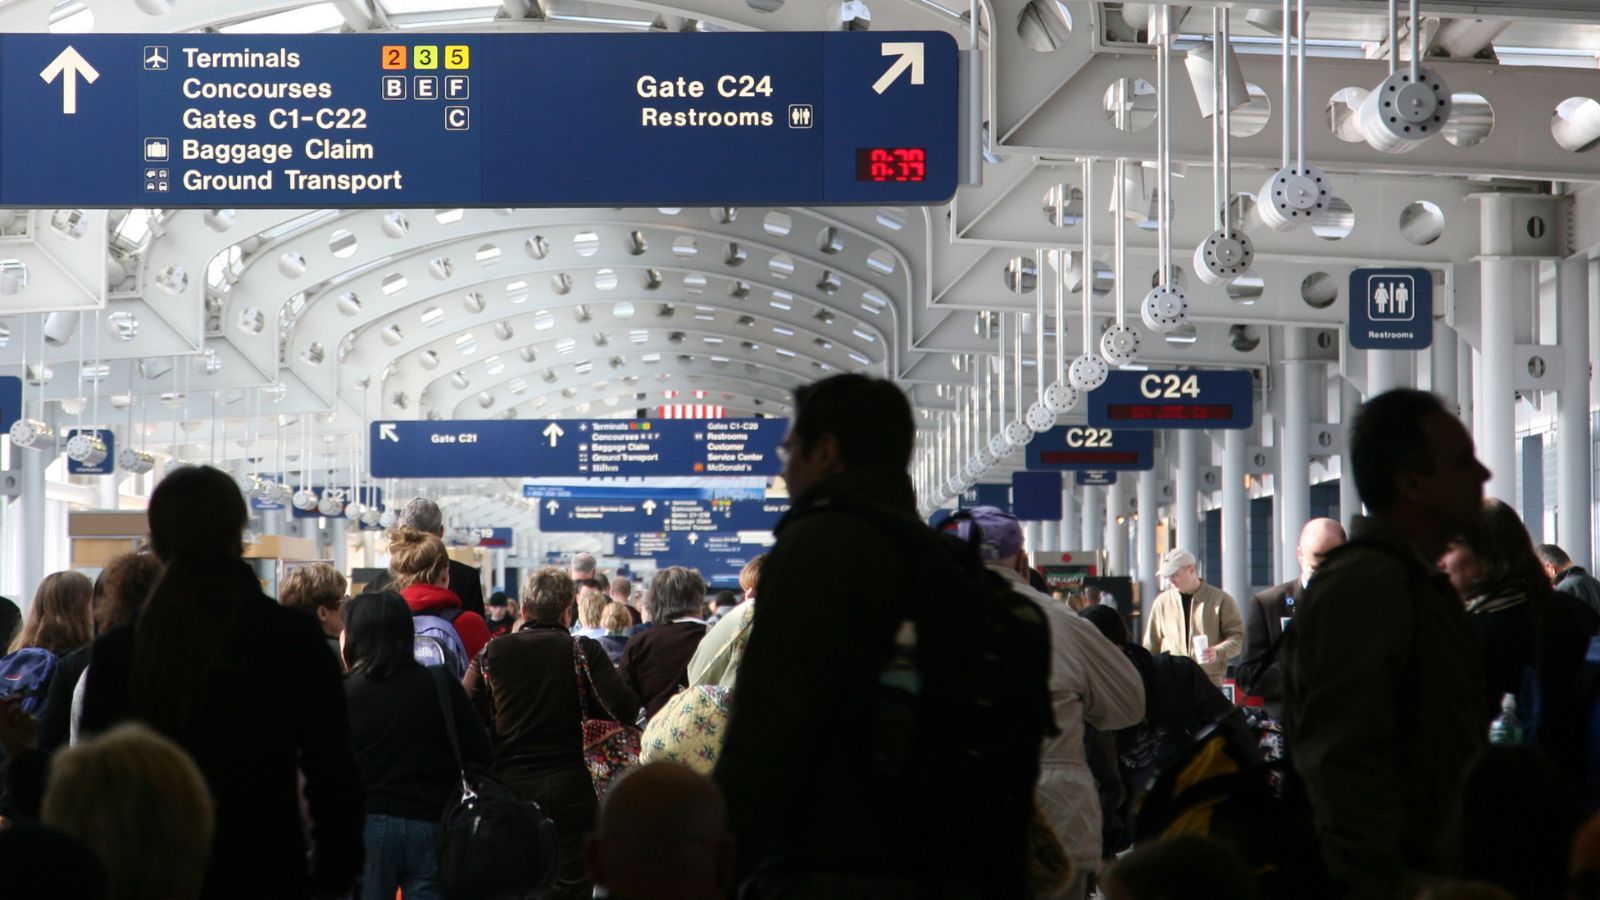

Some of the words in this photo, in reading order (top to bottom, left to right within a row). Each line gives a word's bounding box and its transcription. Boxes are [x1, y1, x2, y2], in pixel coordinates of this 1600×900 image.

[182, 47, 301, 69] Terminals
[388, 49, 401, 66] 2
[420, 49, 432, 66] 3
[451, 49, 464, 66] 5
[182, 77, 332, 99] Concourses
[387, 79, 402, 97] B
[419, 79, 433, 97] E
[450, 79, 464, 97] F
[636, 75, 705, 98] Gate
[717, 74, 774, 98] C24
[182, 108, 257, 130] Gates
[268, 107, 367, 130] C1-C22
[449, 109, 465, 128] C
[642, 107, 774, 127] Restrooms
[182, 139, 293, 164] Baggage
[305, 138, 374, 160] Claim
[182, 169, 273, 191] Ground
[284, 169, 402, 194] Transport
[1368, 330, 1414, 339] Restrooms
[1140, 374, 1200, 398] C24
[592, 423, 628, 431] Terminals
[707, 422, 728, 431] Gates
[729, 422, 759, 431] C1-C20
[431, 434, 456, 443] Gate
[458, 433, 478, 443] C21
[592, 433, 640, 441] Concourses
[707, 433, 748, 441] Restrooms
[1066, 428, 1113, 448] C22
[591, 443, 626, 452] Baggage
[627, 443, 650, 451] Claim
[707, 443, 745, 451] Customer
[592, 453, 621, 462] Ground
[621, 453, 659, 463] Transport
[707, 453, 736, 461] Service
[737, 453, 764, 461] Center
[707, 463, 752, 472] McDonald's
